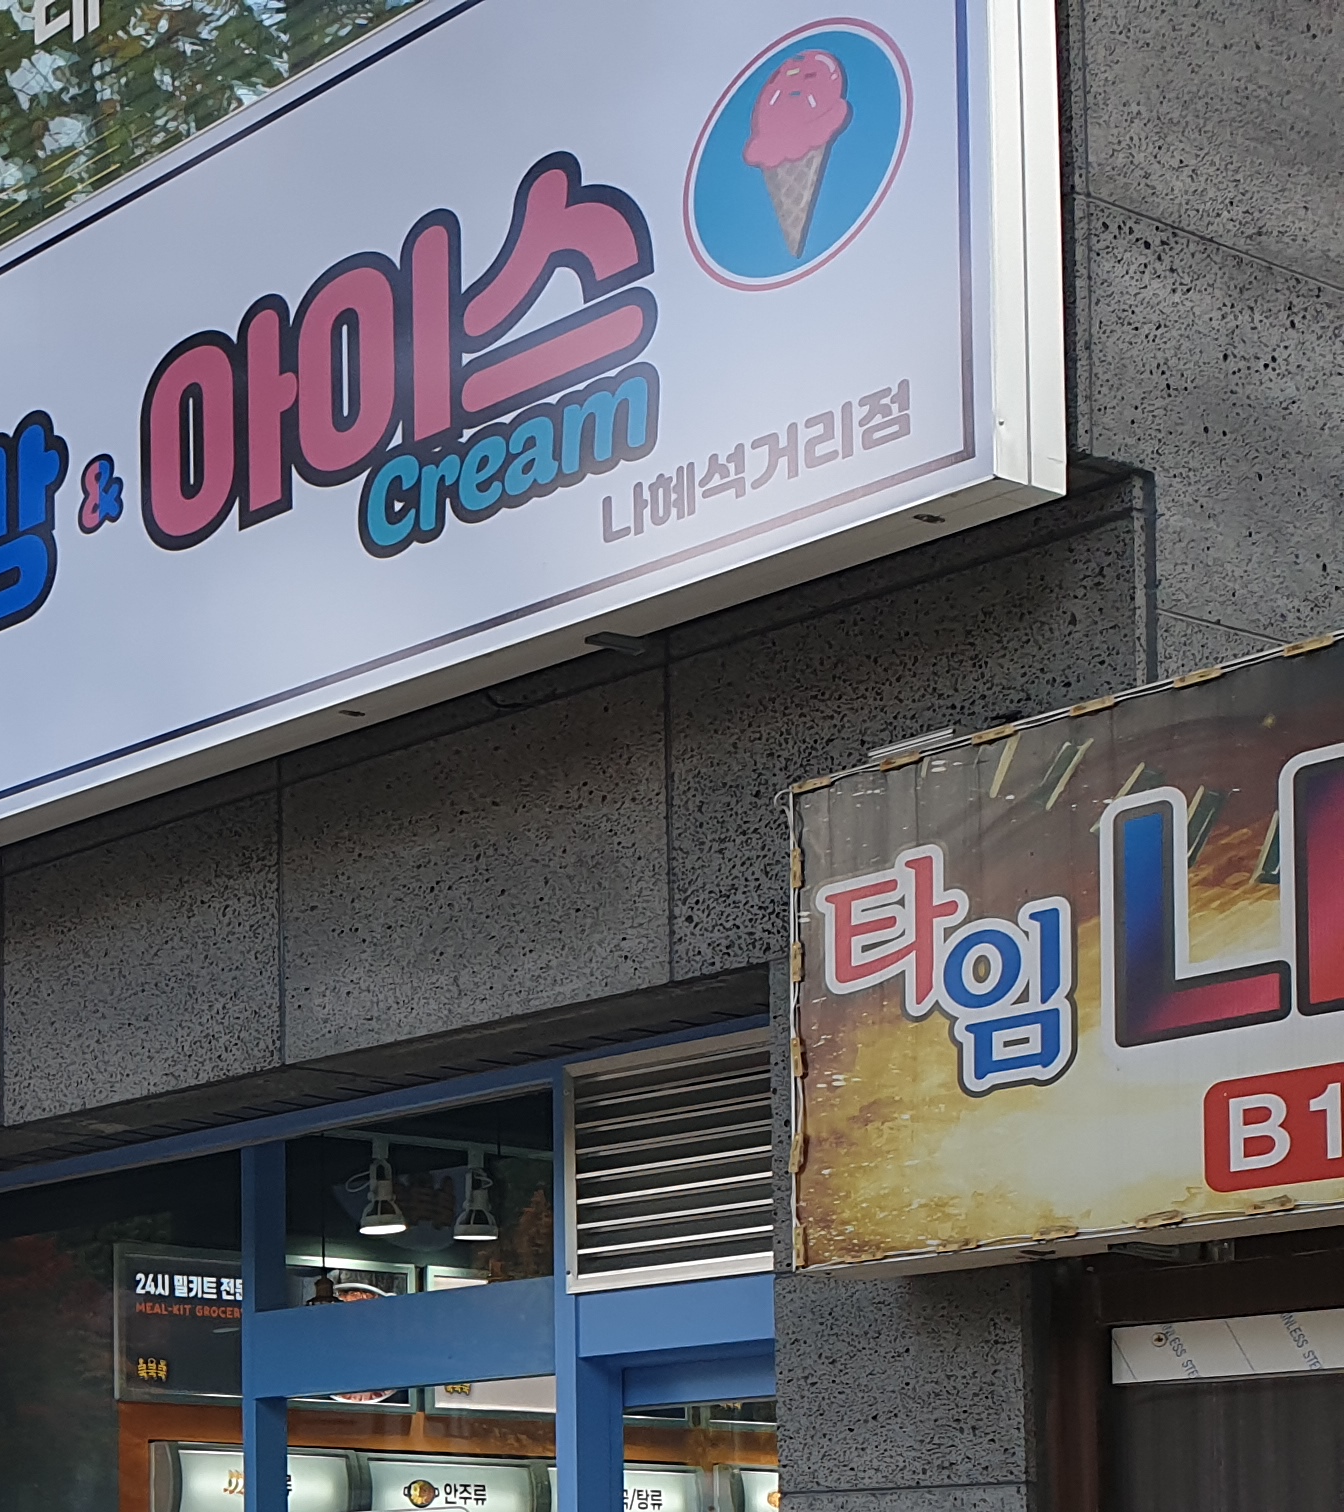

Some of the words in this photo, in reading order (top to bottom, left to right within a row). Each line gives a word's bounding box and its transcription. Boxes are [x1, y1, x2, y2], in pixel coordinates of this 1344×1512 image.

[141, 149, 658, 550] 아이스
[78, 453, 123, 533] &
[602, 378, 911, 543] 나혜석거리점
[816, 843, 1074, 1096] 타임
[135, 1272, 170, 1296] 24시
[173, 1275, 218, 1299] 밀키트
[135, 1302, 192, 1316] MEAL-KIT
[443, 1482, 488, 1506] 안주류
